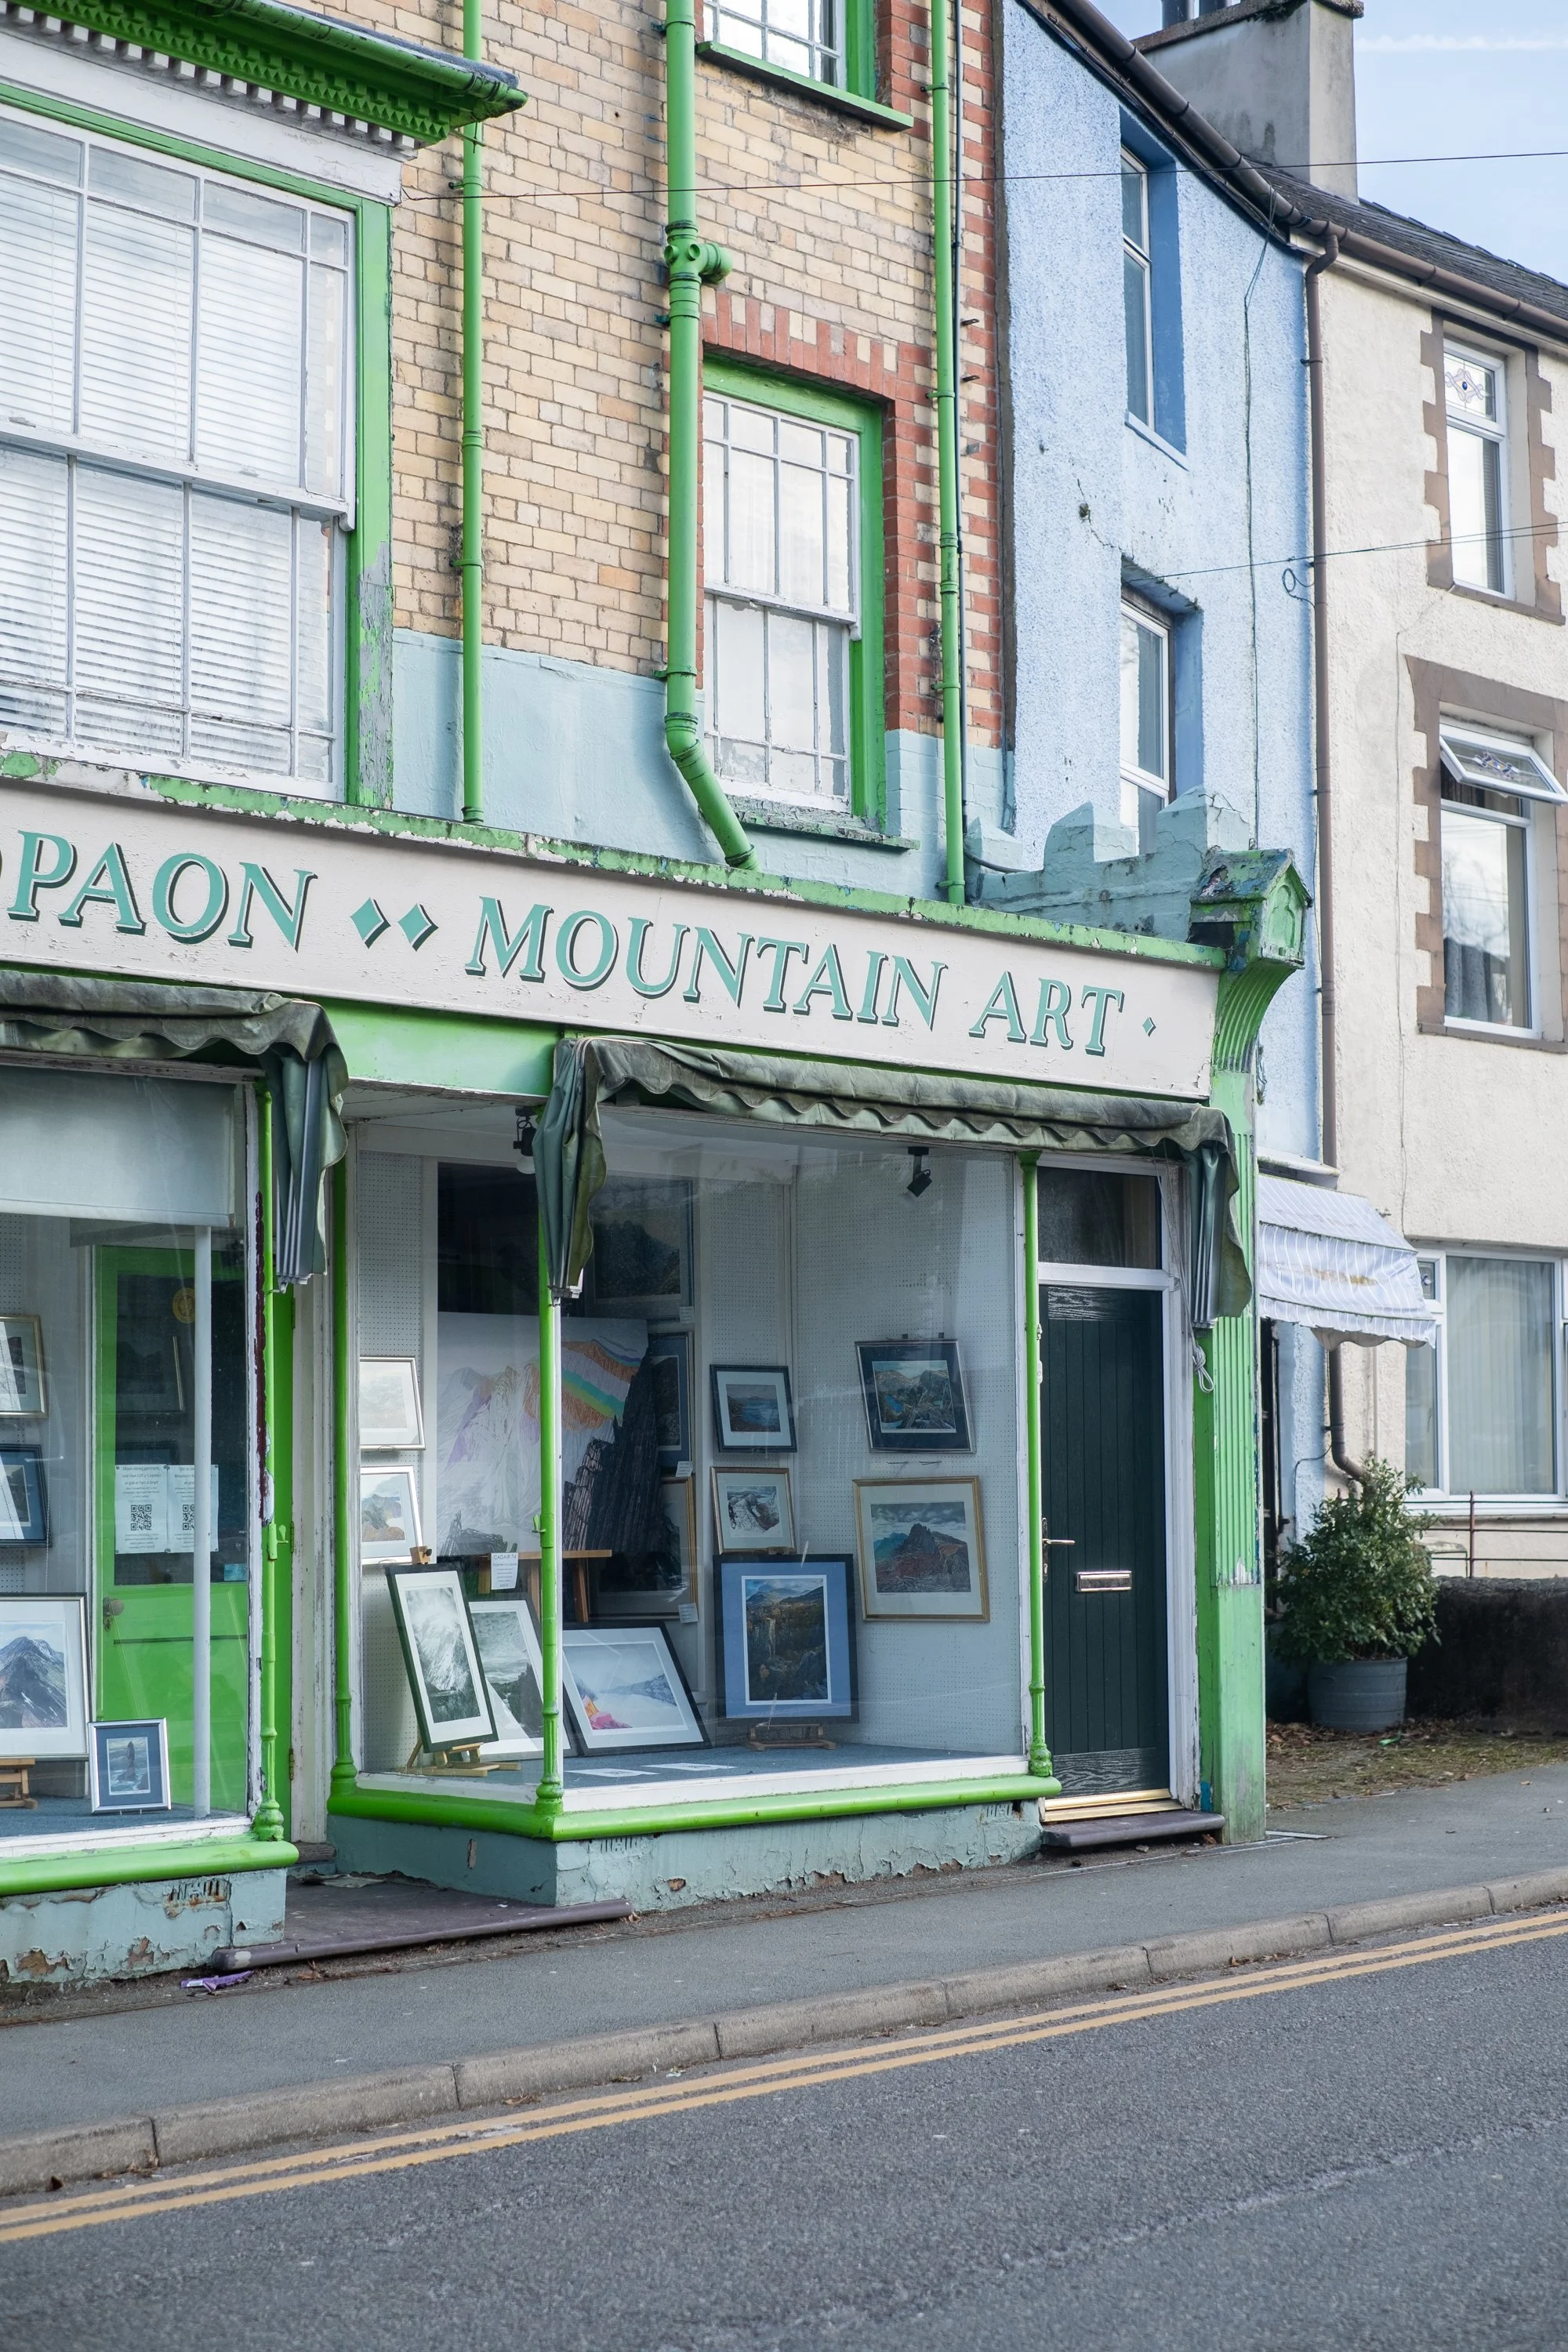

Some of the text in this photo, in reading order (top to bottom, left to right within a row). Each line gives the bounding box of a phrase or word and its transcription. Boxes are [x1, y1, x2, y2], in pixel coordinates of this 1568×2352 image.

[0, 829, 1125, 1058] PAON MOUNTAIN ART
